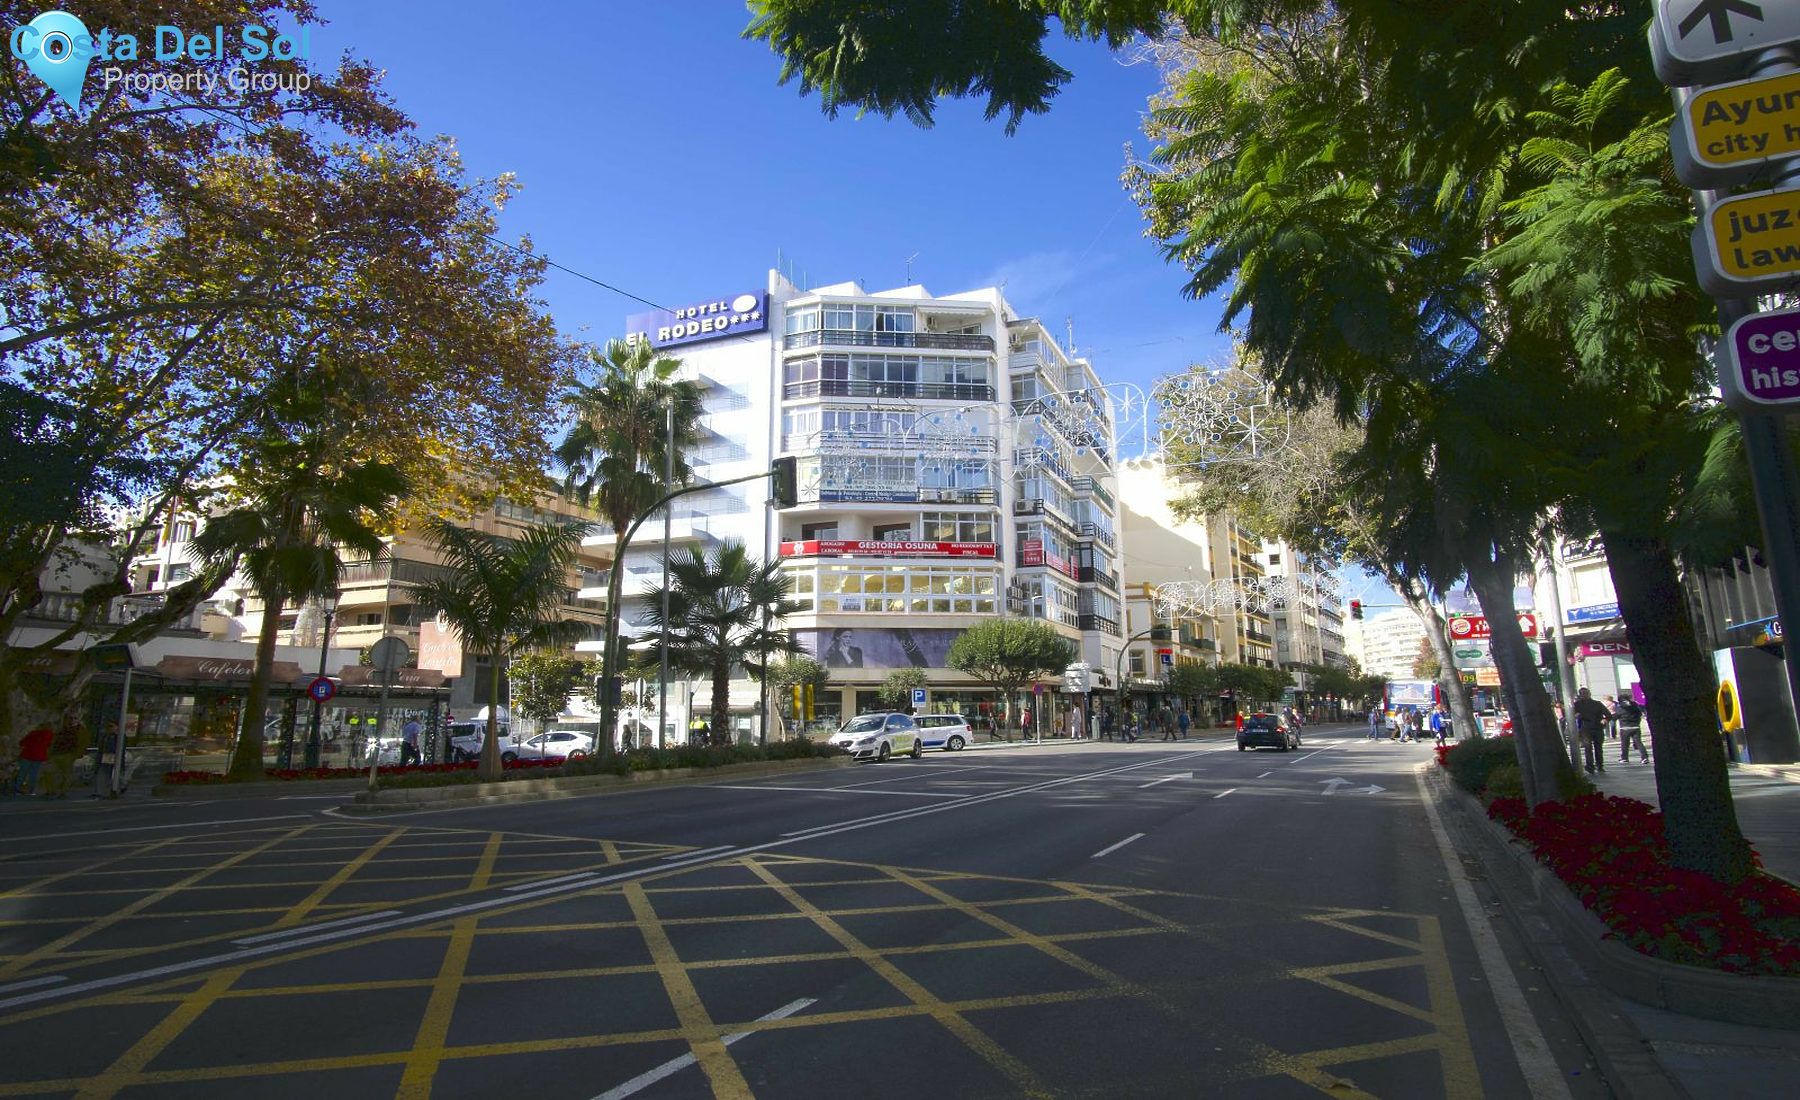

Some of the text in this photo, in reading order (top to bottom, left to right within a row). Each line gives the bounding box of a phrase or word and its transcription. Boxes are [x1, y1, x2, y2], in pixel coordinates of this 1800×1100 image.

[1707, 132, 1770, 156] city
[1729, 209, 1800, 243] juz
[676, 301, 729, 320] HOTEL
[1748, 330, 1800, 354] ce
[1751, 366, 1800, 390] his
[858, 541, 938, 550] GESTORIA OSUNA
[1589, 642, 1630, 653] DEN
[197, 660, 254, 679] Cafeter
[915, 690, 924, 701] P
